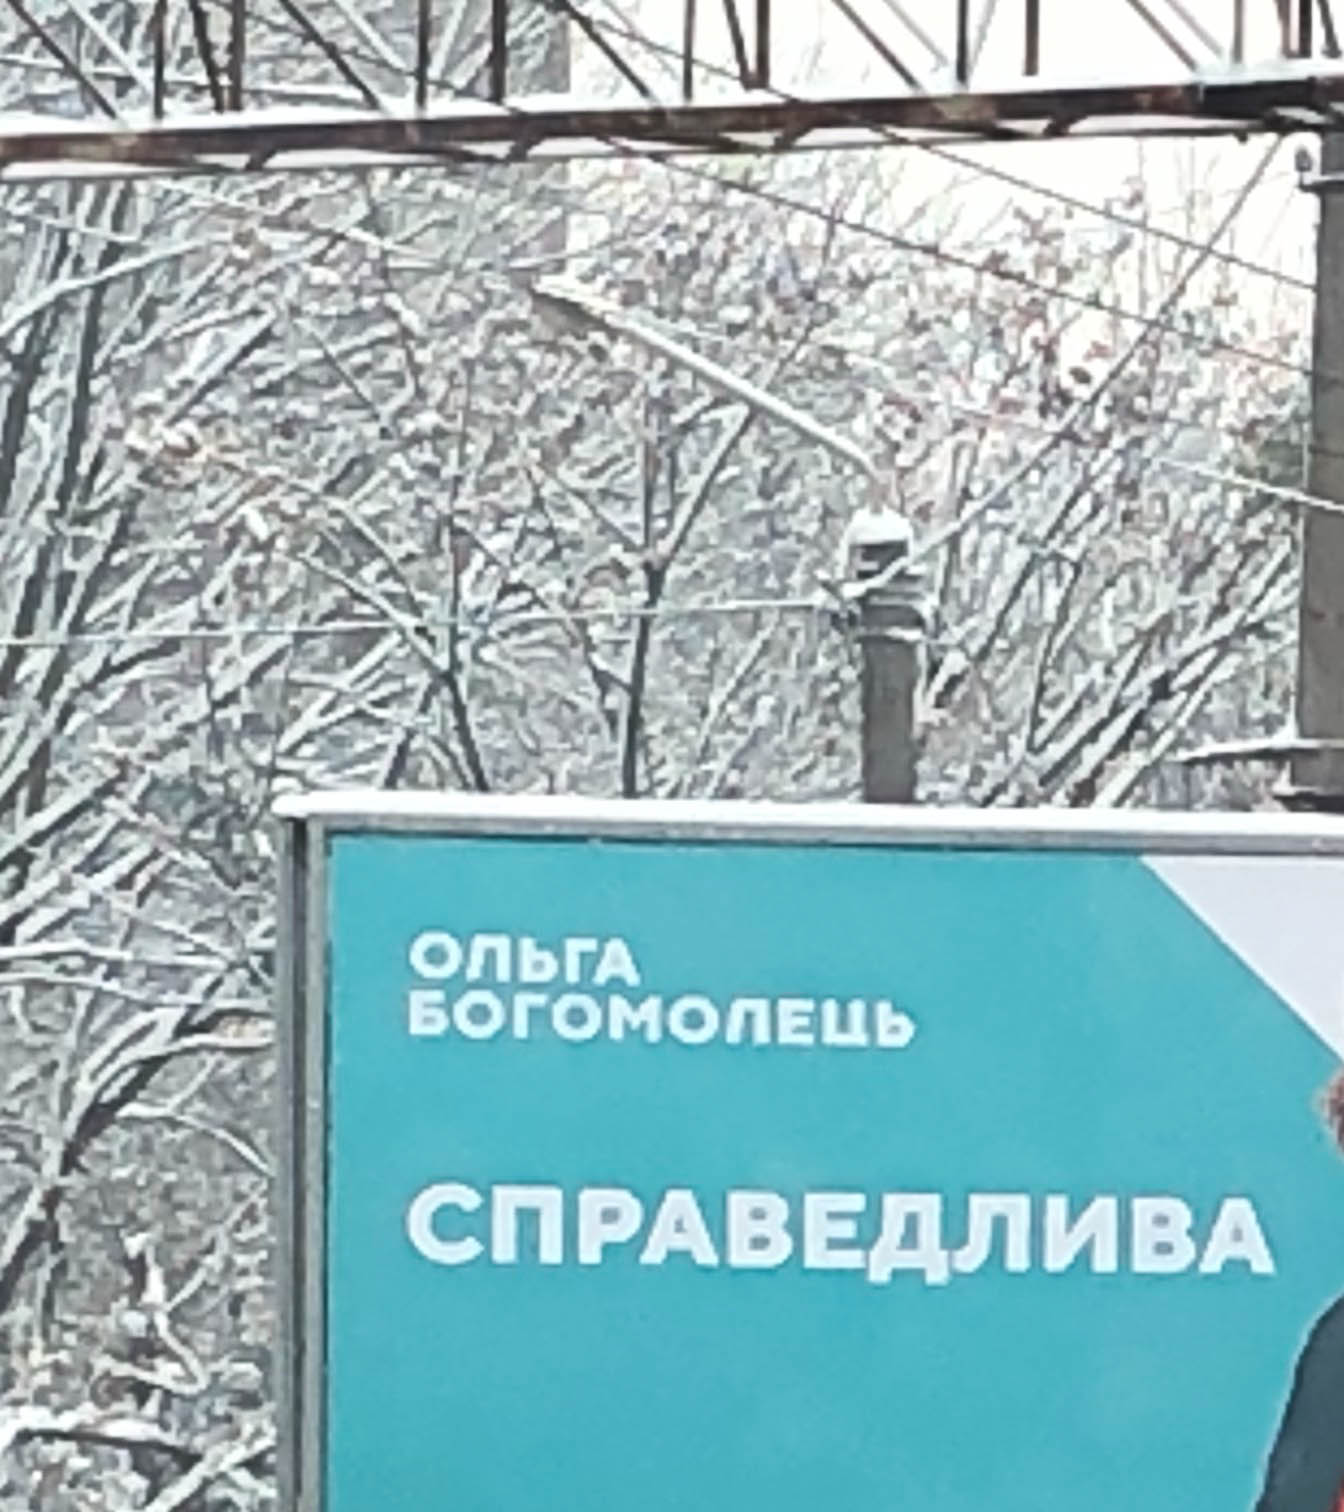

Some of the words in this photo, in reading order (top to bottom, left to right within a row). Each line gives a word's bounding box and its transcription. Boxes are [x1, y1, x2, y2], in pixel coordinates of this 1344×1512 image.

[408, 931, 641, 986] ОЛЬГА
[408, 989, 917, 1048] БОГОМОЛЕЦЬ
[407, 1183, 1275, 1285] СПРАВЕДЛИВА
